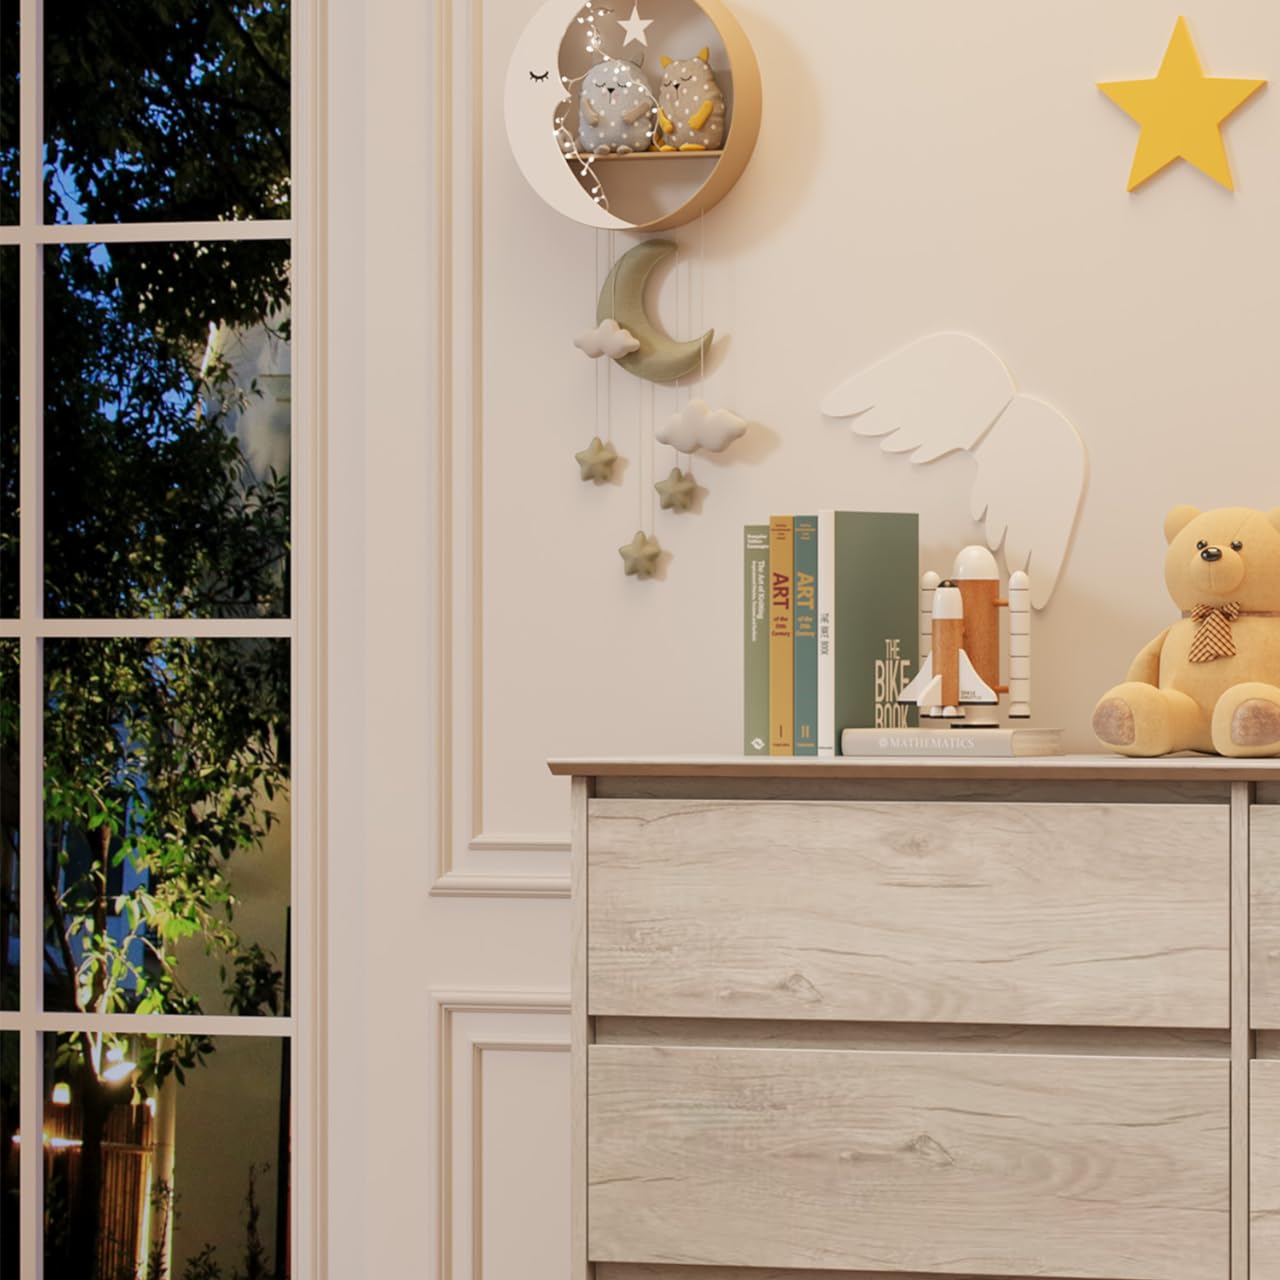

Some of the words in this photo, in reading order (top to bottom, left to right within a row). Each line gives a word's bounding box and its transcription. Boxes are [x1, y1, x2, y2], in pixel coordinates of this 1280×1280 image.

[773, 572, 789, 609] ART
[797, 571, 814, 610] ART
[885, 639, 900, 659] THE
[875, 660, 910, 702] BIKE
[875, 703, 908, 728] BOOK
[889, 736, 976, 749] MATHEMATICS
